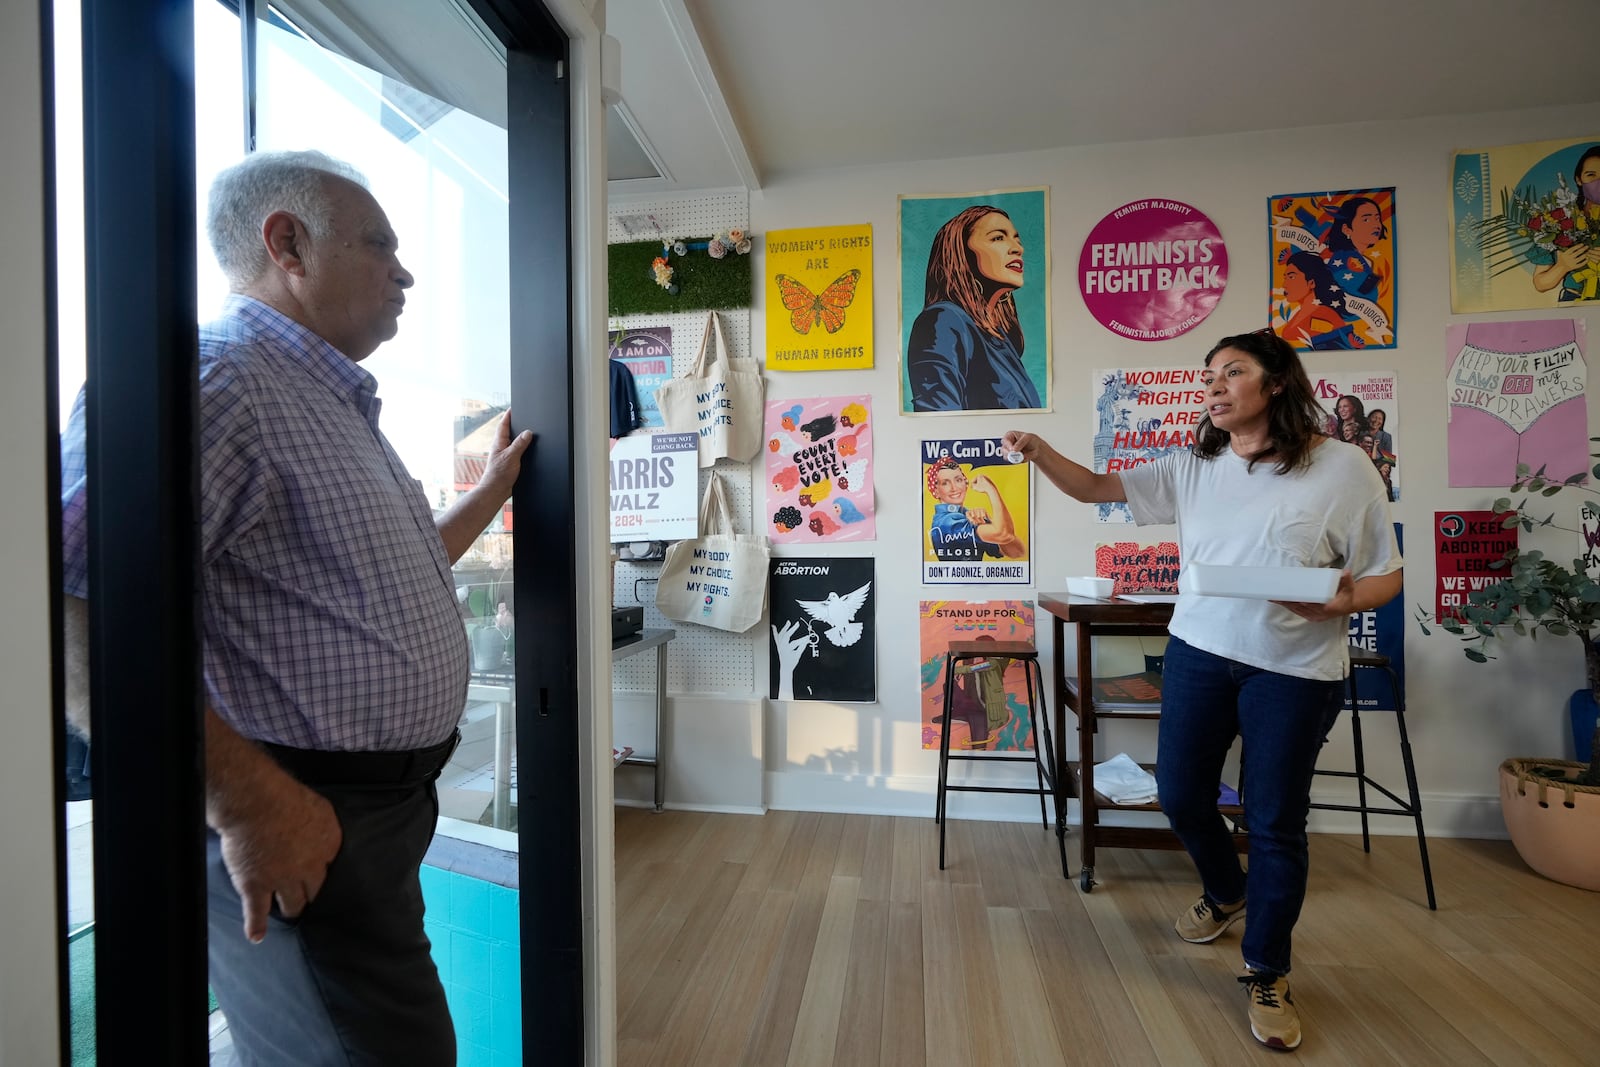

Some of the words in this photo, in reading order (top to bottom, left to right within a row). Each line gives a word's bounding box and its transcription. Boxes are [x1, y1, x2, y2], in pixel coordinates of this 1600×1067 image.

[1114, 202, 1148, 220] FEMINIST
[1151, 201, 1192, 216] MAJORITY
[1281, 230, 1296, 240] OUR
[769, 240, 825, 254] WOMEN'S
[829, 236, 870, 249] RIGHTS
[1092, 238, 1213, 268] FEMINISTS
[806, 258, 829, 270] ARE
[1086, 268, 1152, 294] FIGHT
[1156, 265, 1220, 291] BACK
[1348, 300, 1363, 311] OUR
[1109, 316, 1200, 338] FEMINISTMAJORITY.ORG
[618, 348, 624, 356] I
[626, 347, 644, 356] AM
[646, 346, 662, 355] ON
[776, 349, 819, 360] HUMAN
[824, 346, 864, 359] RIGHTS
[1459, 349, 1492, 370] KEEP
[1496, 356, 1529, 373] YOUR
[1534, 348, 1575, 370] FILTHY
[1455, 369, 1500, 390] LAWS
[1505, 378, 1530, 392] OFF
[1352, 384, 1392, 393] DEMOCRACY
[696, 392, 710, 404] MY
[1138, 390, 1204, 406] RIGHTS
[1381, 392, 1392, 400] LIKE
[1452, 388, 1496, 408] SILKY
[1498, 376, 1584, 420] DRAWERS
[698, 409, 712, 420] MY
[1162, 412, 1200, 425] ARE
[700, 426, 712, 438] MY
[1113, 430, 1197, 448] HUMAN
[793, 438, 836, 464] COUNT
[926, 442, 948, 458] We
[952, 441, 980, 458] Can
[799, 450, 836, 475] EVERY
[800, 461, 848, 488] VOTE!
[615, 514, 643, 527] 2024
[1440, 540, 1517, 554] ABORTION
[694, 548, 708, 558] MY
[708, 552, 731, 562] BODY.
[1114, 554, 1150, 566] EVERY
[690, 565, 704, 575] MY
[706, 567, 733, 580] CHOICE.
[774, 566, 830, 576] ABORTION
[929, 567, 950, 578] DON'T
[952, 567, 984, 578] AGONIZE,
[986, 567, 1024, 578] ORGANIZE!
[1124, 572, 1131, 582] A
[686, 582, 701, 592] MY
[703, 584, 730, 597] RIGHTS.
[1442, 576, 1466, 590] WE
[1441, 593, 1460, 607] GO
[936, 610, 972, 618] STAND
[976, 610, 990, 618] UP
[994, 610, 1016, 618] FOR
[954, 619, 998, 630] LOVE
